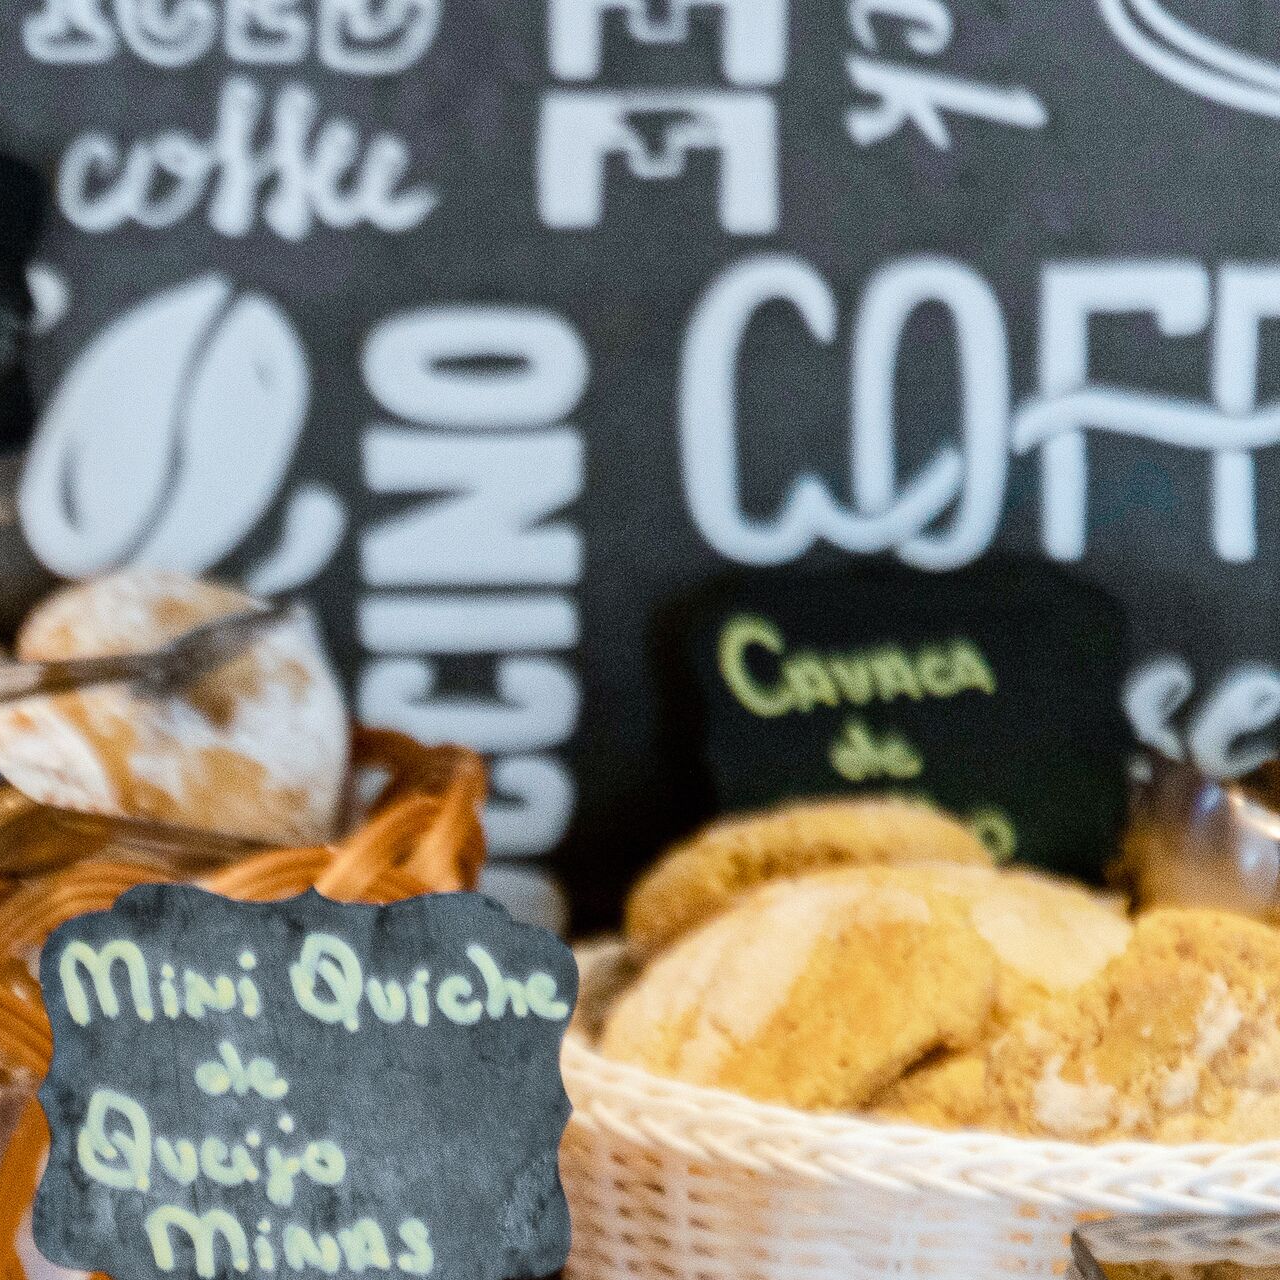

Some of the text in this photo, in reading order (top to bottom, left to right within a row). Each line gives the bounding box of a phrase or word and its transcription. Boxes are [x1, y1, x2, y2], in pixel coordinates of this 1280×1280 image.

[56, 74, 440, 242] coffee
[58, 932, 571, 1031] Mini Quiche
[194, 1040, 289, 1099] de
